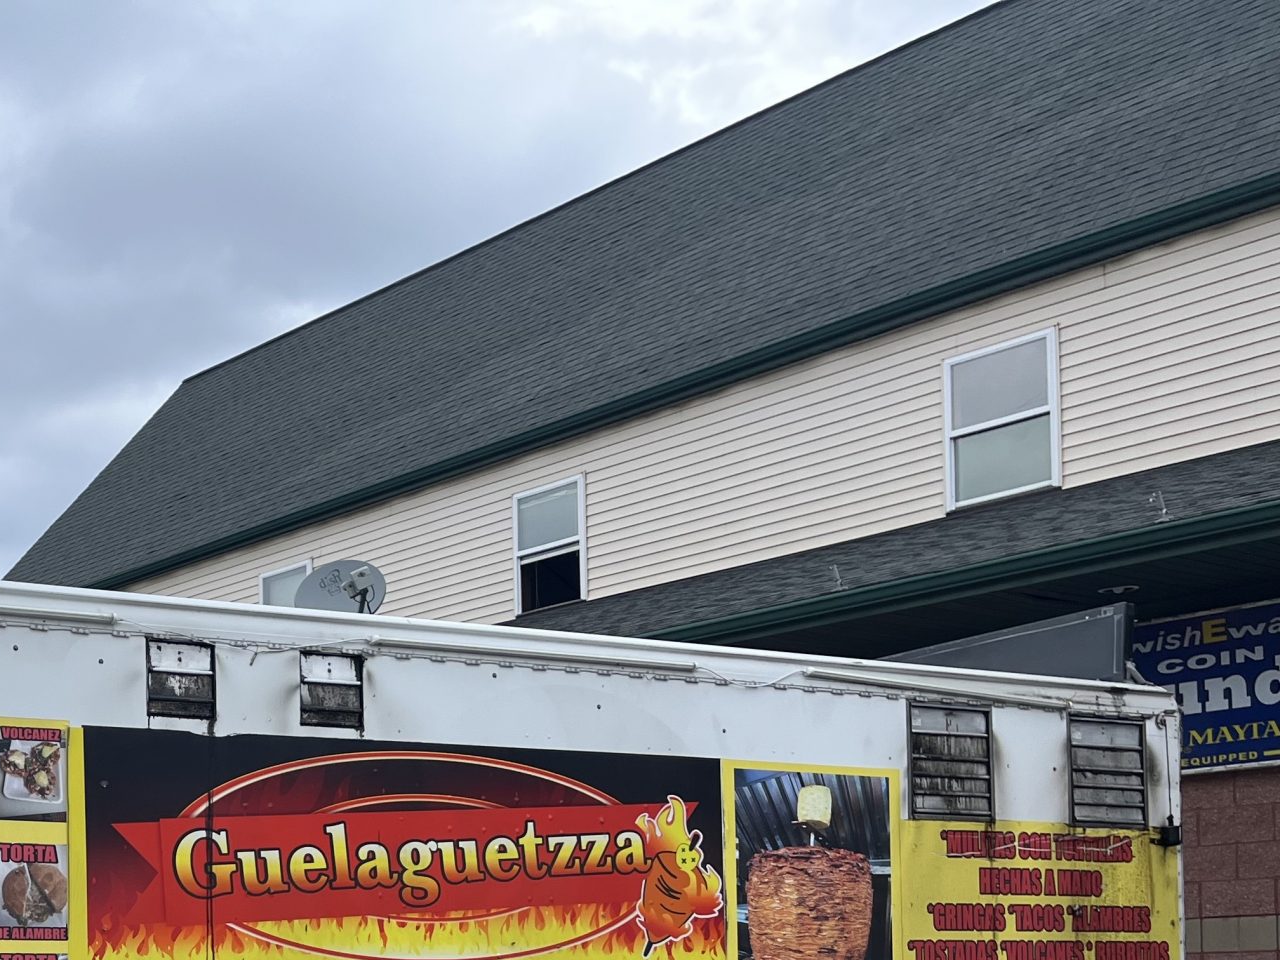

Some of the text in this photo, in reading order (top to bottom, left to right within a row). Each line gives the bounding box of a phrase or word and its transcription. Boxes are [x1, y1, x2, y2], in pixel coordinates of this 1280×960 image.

[1157, 645, 1264, 674] COIN
[2, 727, 61, 741] VOLCANEZ
[1189, 720, 1280, 746] MAYTA
[1181, 751, 1258, 767] EQUIPPED
[0, 844, 57, 863] TORTA
[173, 820, 652, 907] Guelaguetzza
[979, 867, 1103, 897] HECHAS A MANO
[12, 927, 67, 940] ALAMBRE
